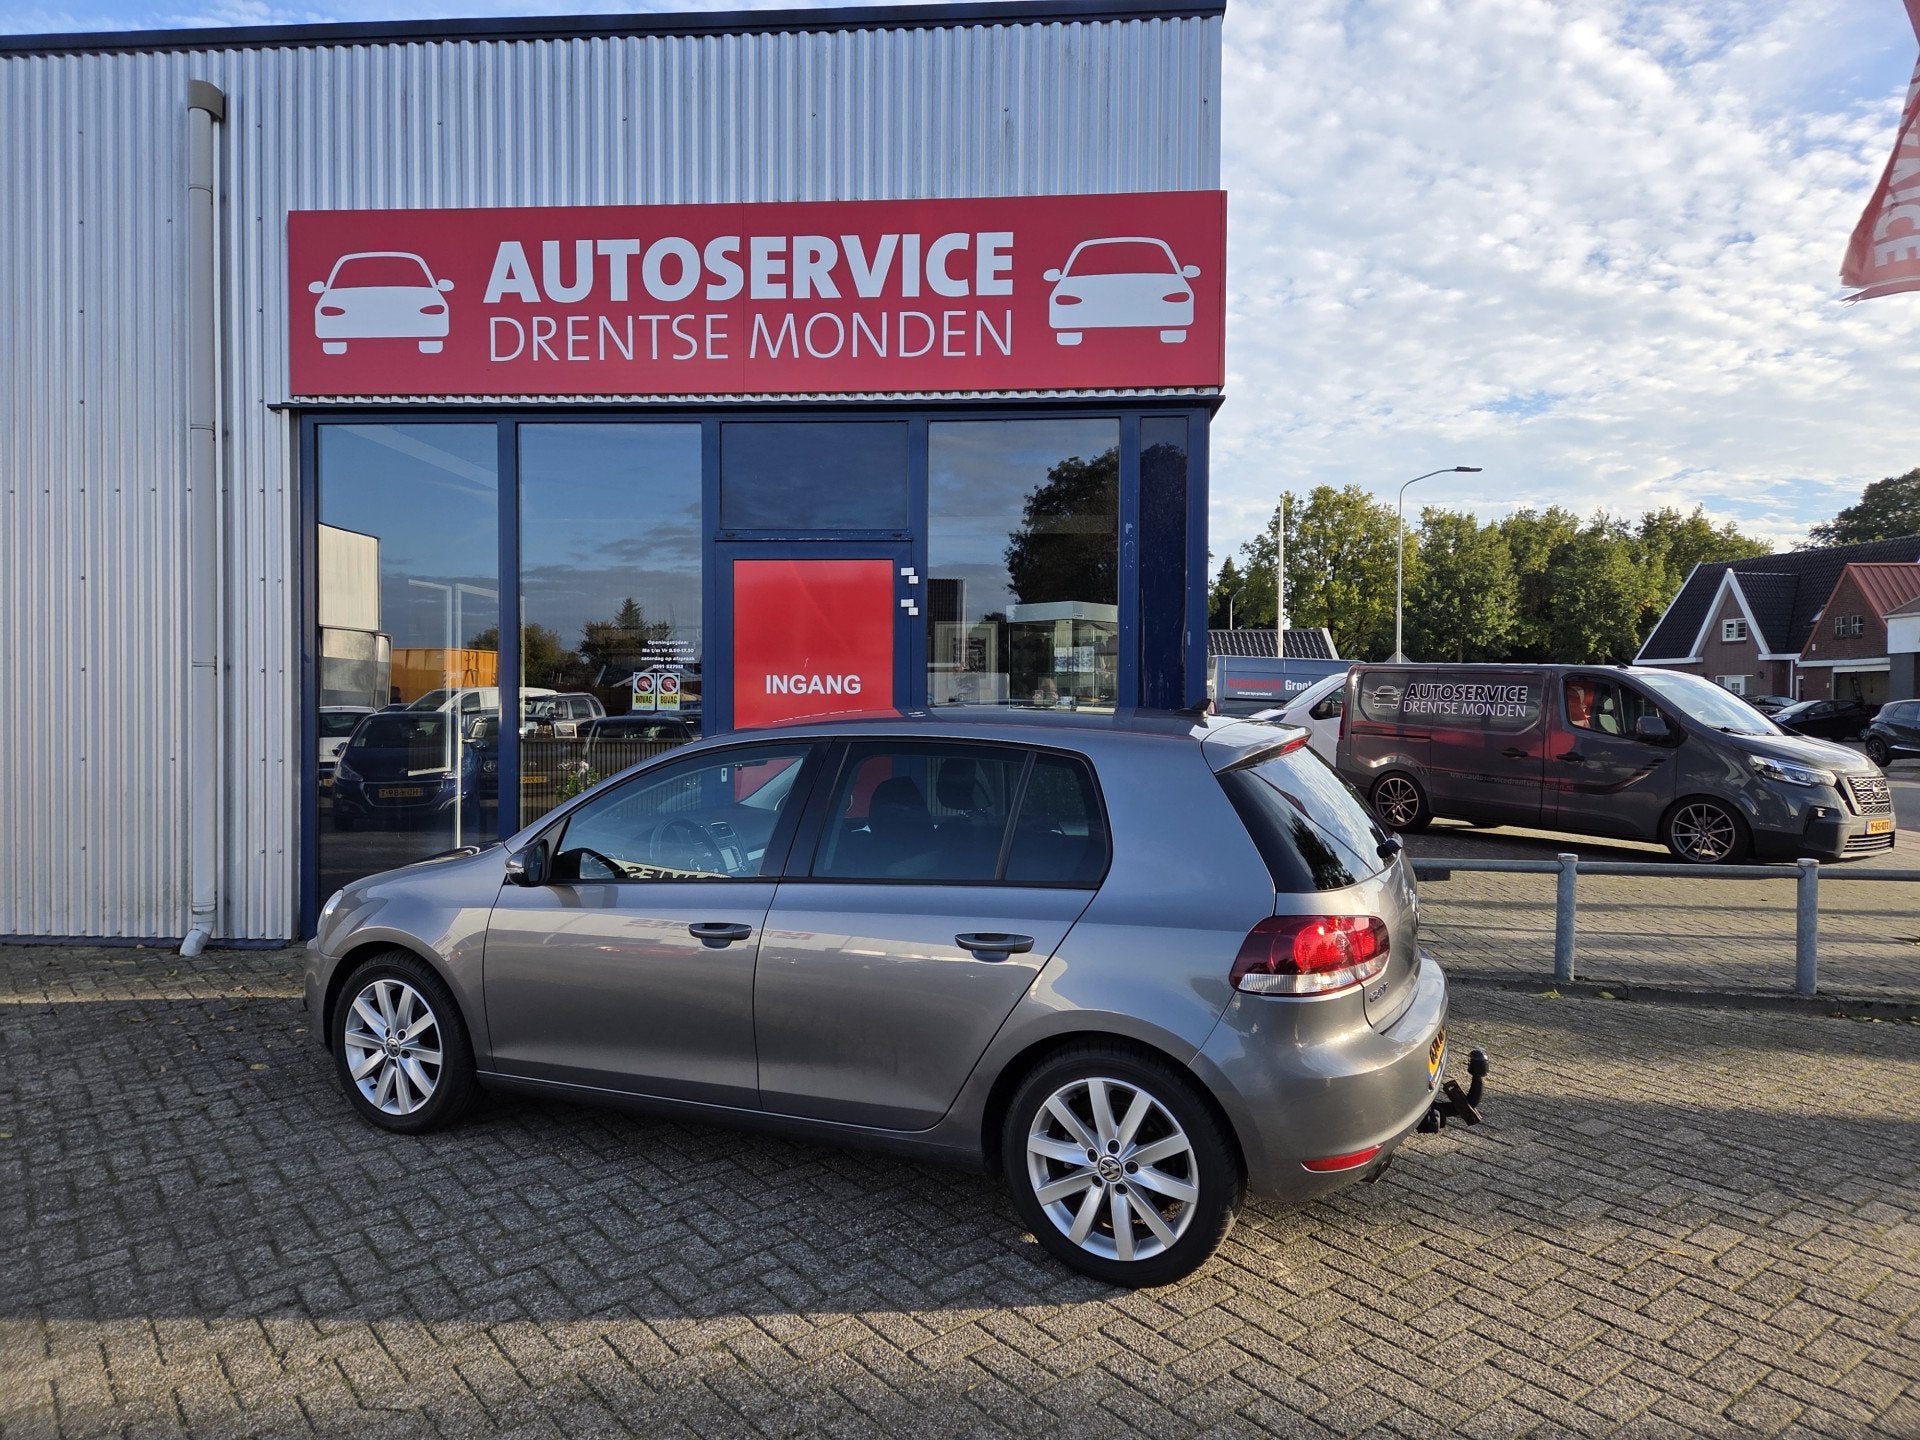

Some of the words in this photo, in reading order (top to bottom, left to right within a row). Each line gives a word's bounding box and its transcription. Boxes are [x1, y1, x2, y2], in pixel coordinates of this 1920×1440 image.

[483, 231, 1014, 303] AUTOSERVICE
[489, 313, 729, 362] DRENTSE
[749, 309, 1012, 360] MONDEN
[766, 674, 861, 695] INGANG
[1405, 683, 1528, 703] AUTOSERVICE
[635, 695, 653, 704] BOVAG
[1403, 700, 1458, 714] DRENTSE
[1461, 703, 1526, 717] MONDEN
